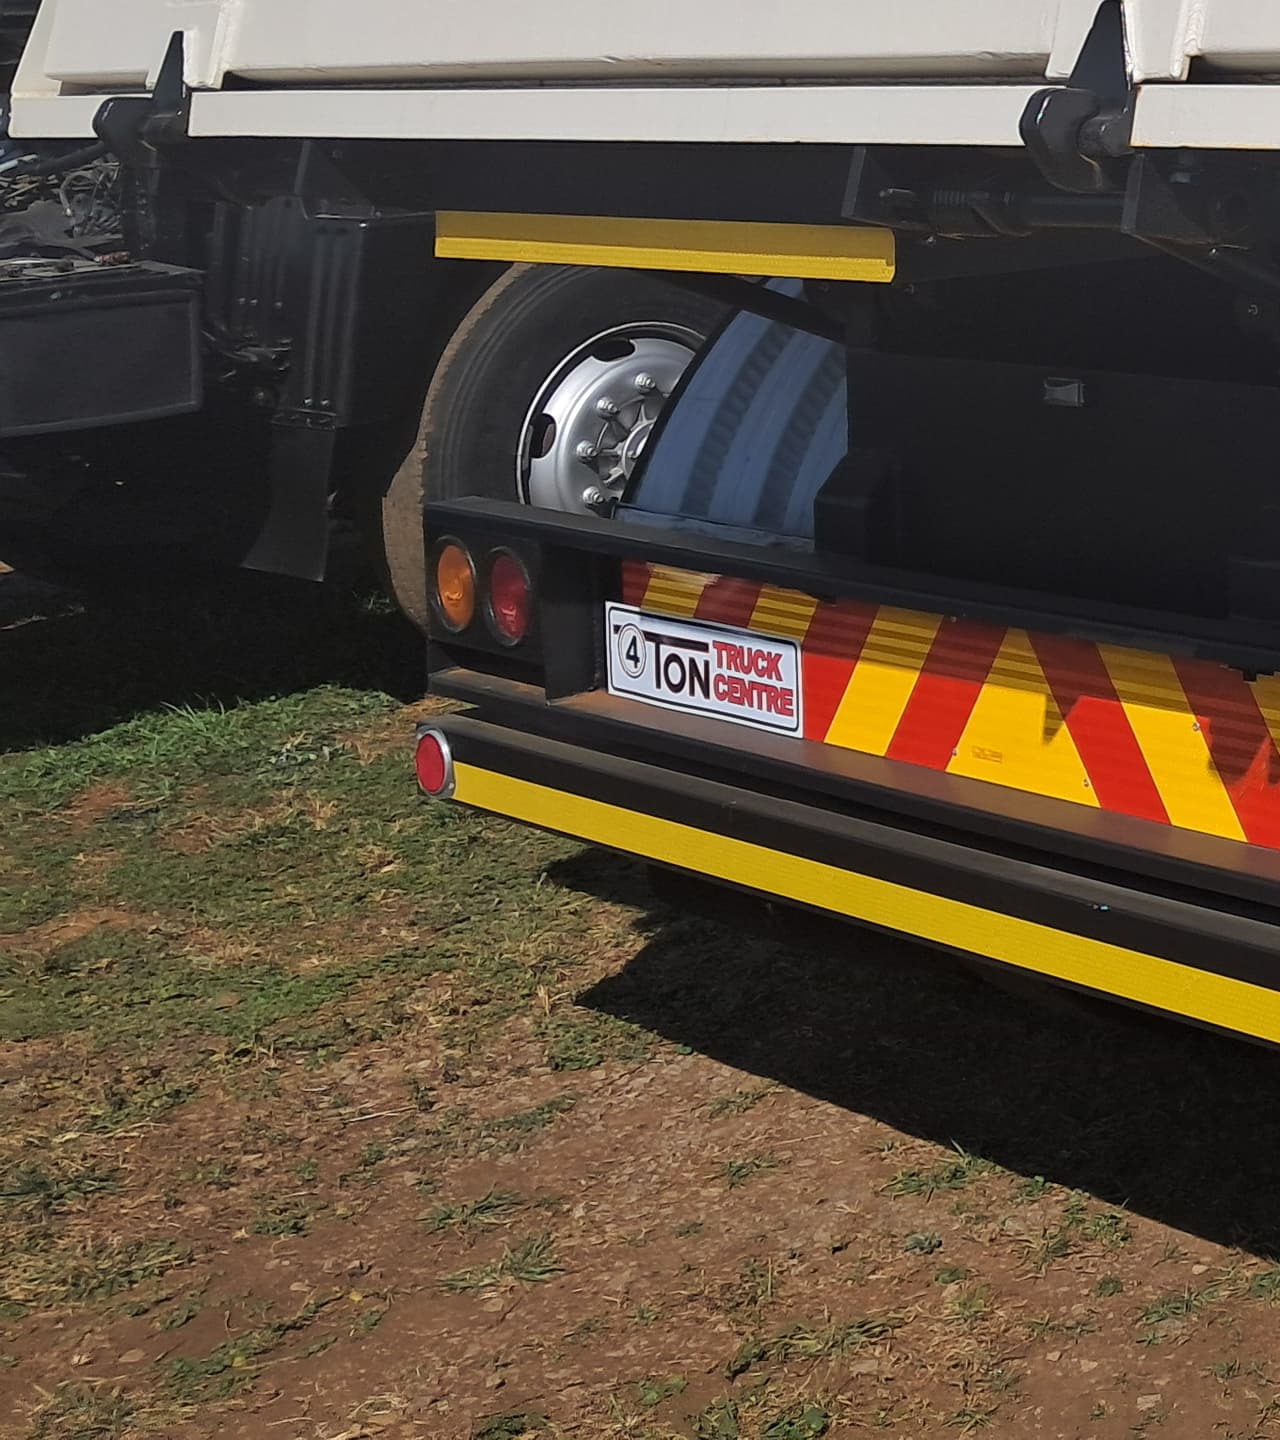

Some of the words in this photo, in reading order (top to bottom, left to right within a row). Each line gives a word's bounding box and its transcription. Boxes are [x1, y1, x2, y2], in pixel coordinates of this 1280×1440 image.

[625, 634, 641, 669] 4
[642, 629, 711, 700] TON
[713, 640, 783, 681] TRUCK
[713, 673, 794, 718] CENTRE
